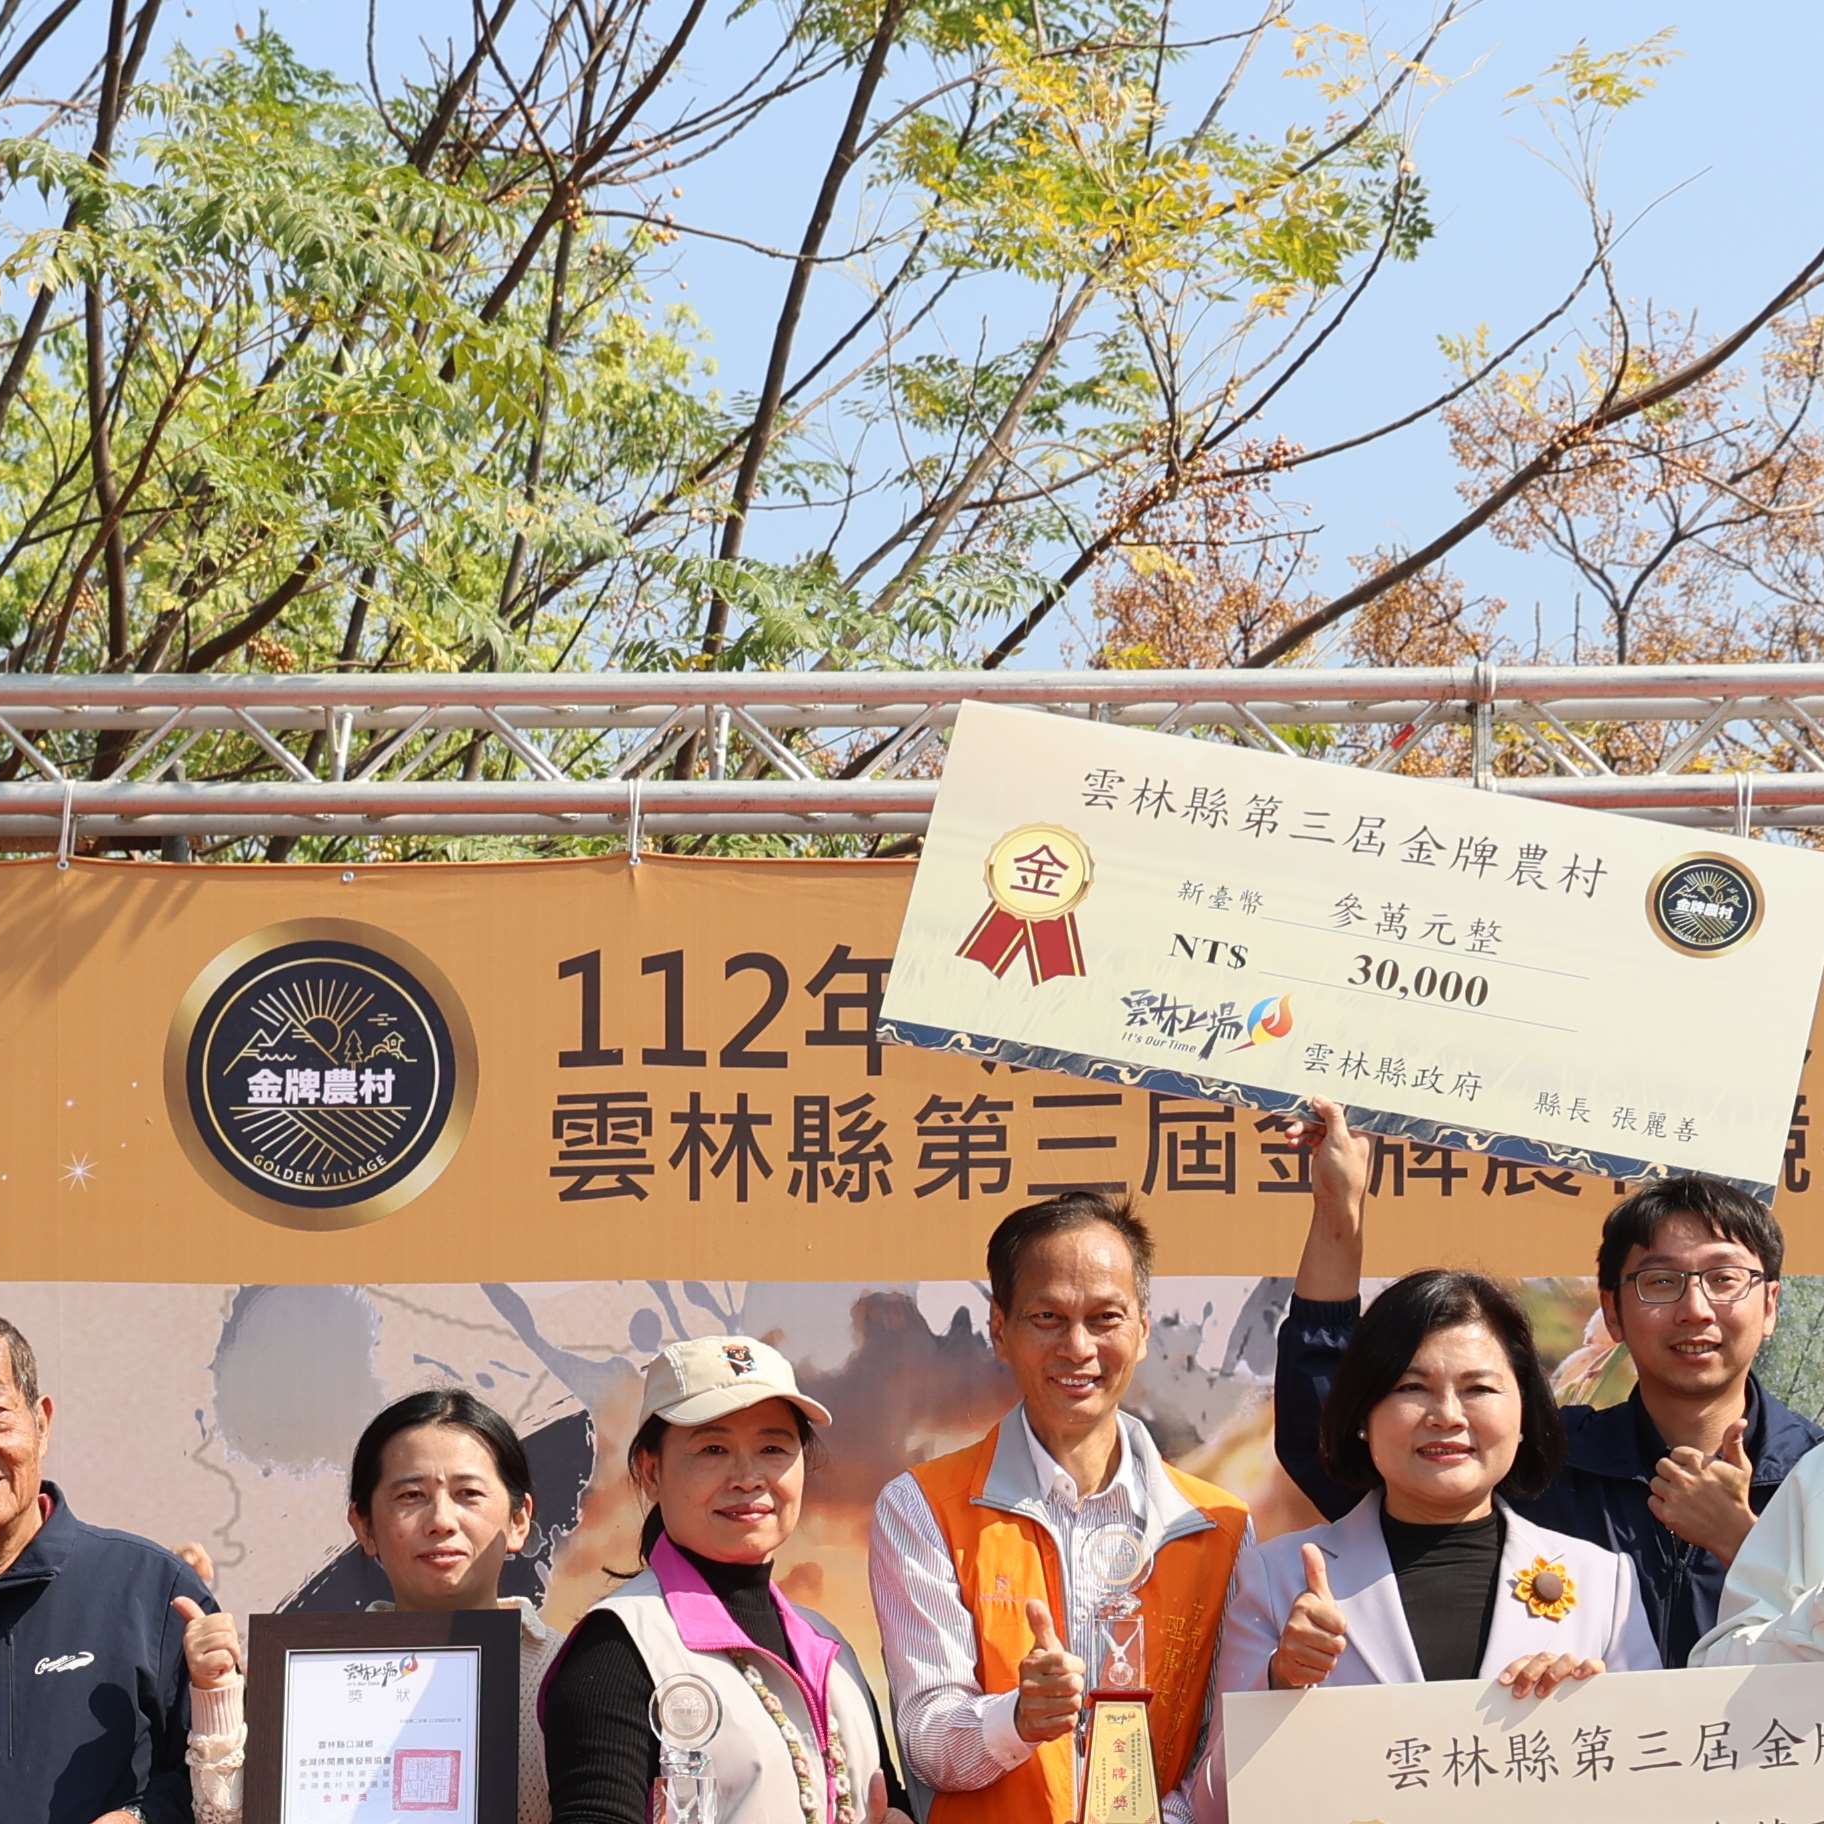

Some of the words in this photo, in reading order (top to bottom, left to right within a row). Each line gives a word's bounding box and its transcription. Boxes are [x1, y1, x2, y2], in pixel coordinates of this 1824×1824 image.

[1013, 844, 1071, 895] 金
[1080, 768, 1608, 898] 雲林縣第三屆金牌農村
[1177, 880, 1264, 917] 新臺幣
[1328, 892, 1504, 955] 參萬元整
[1169, 933, 1248, 970] NT$
[1347, 953, 1488, 1008] 30,000
[558, 943, 894, 1076] 112年
[1144, 1035, 1166, 1049] Our
[1167, 1039, 1196, 1054] Time
[246, 1067, 398, 1106] 金牌農村
[1303, 1042, 1483, 1103] 雲林縣政府
[1533, 1091, 1591, 1124] 縣長
[1612, 1106, 1699, 1143] 張麗善
[253, 1154, 315, 1185] GOLDEN
[322, 1155, 387, 1184] VILLAGE
